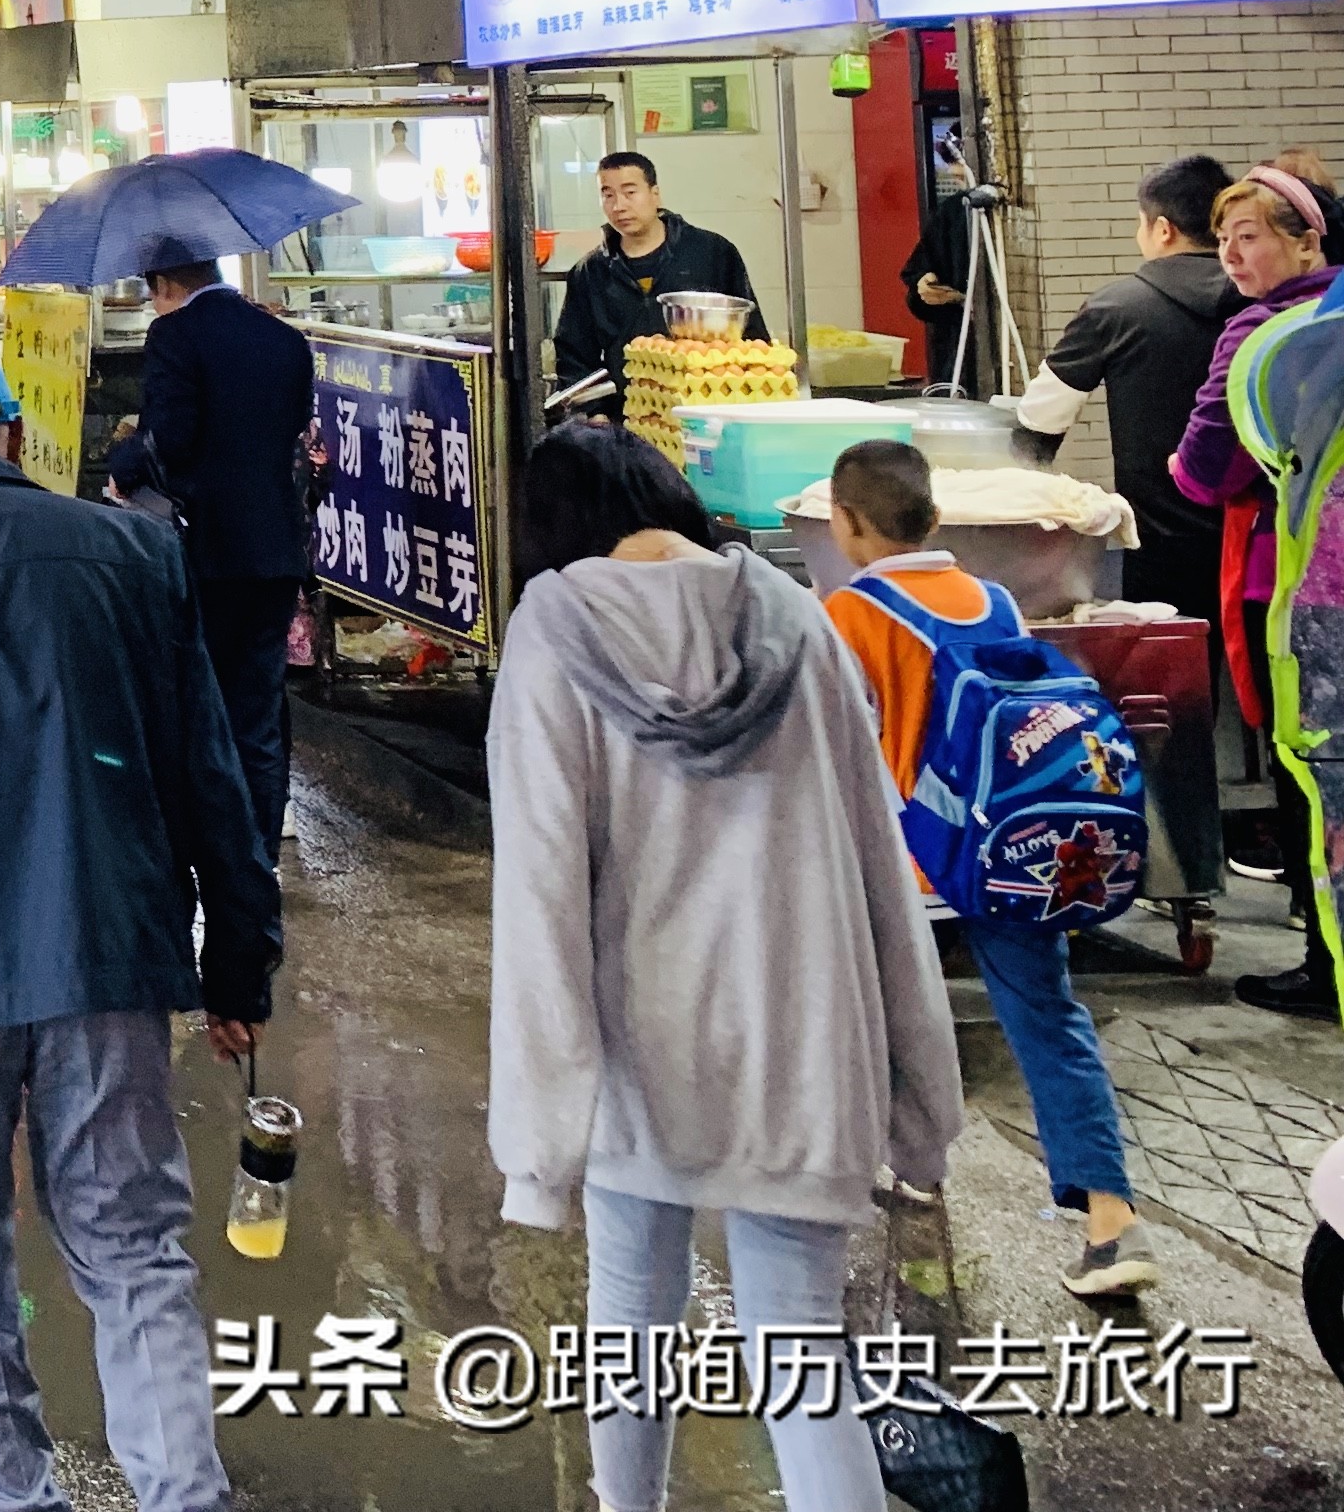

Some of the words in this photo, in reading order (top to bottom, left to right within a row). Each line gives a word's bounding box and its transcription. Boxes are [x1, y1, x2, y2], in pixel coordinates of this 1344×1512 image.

[378, 402, 472, 508] 粉蒸肉
[382, 510, 479, 622] 炒豆芽
